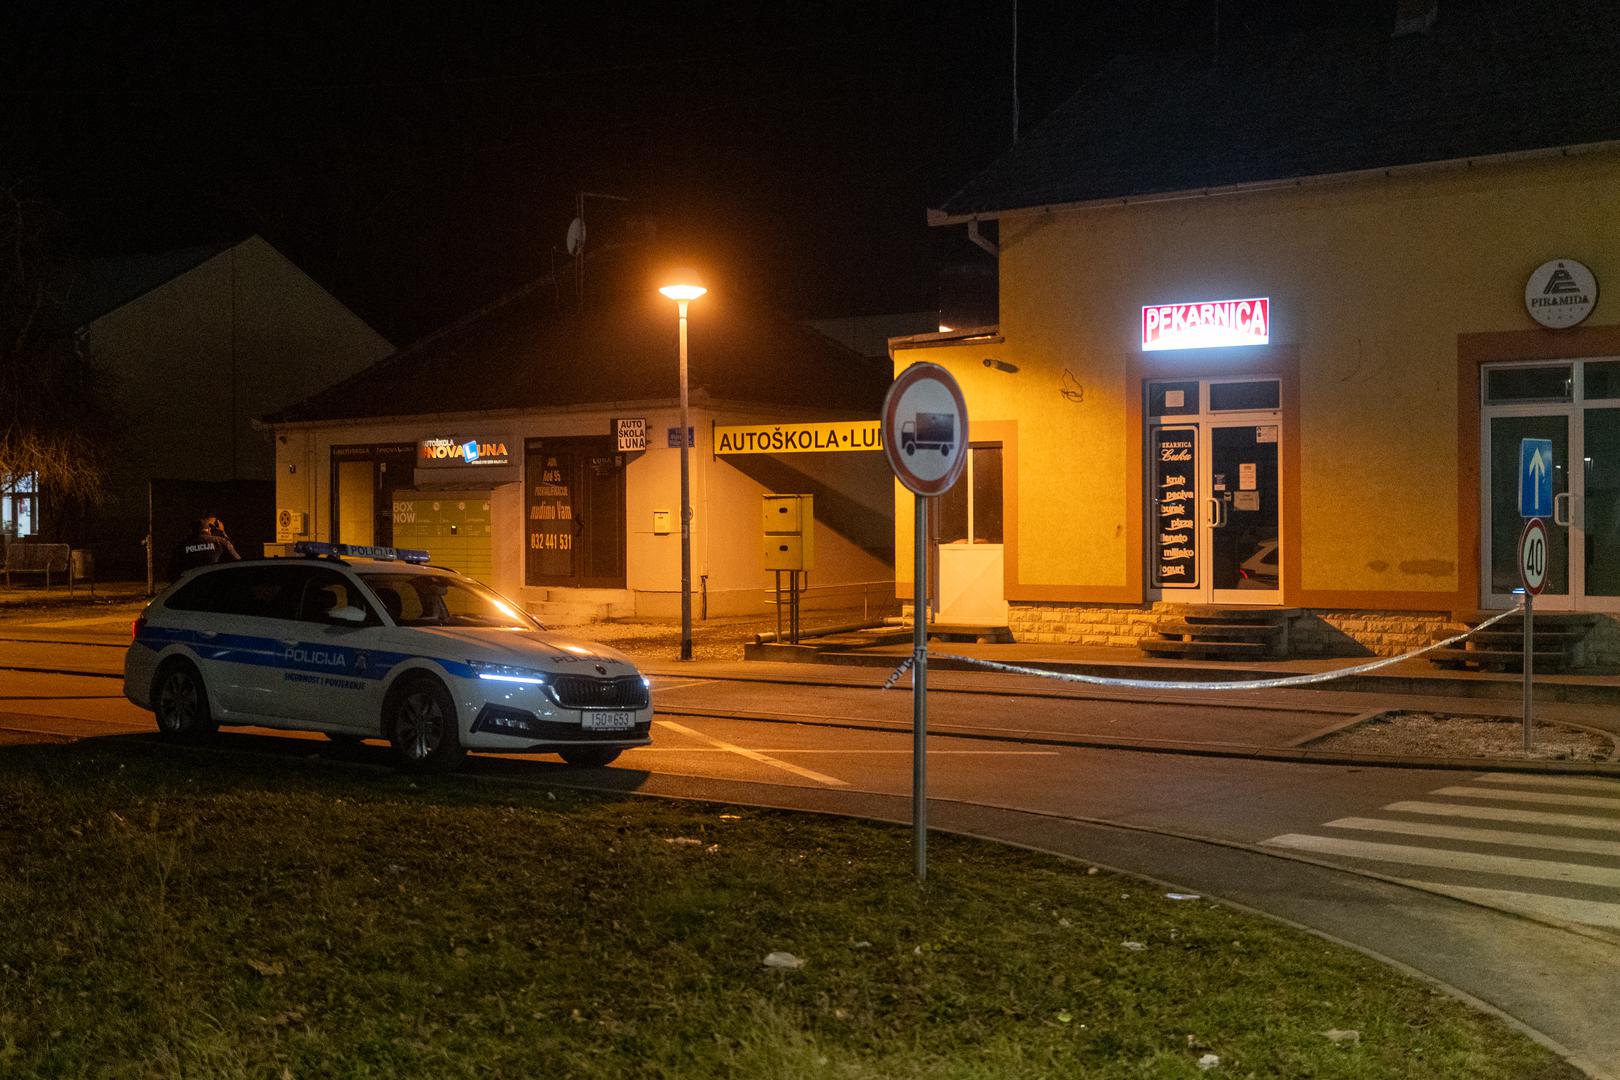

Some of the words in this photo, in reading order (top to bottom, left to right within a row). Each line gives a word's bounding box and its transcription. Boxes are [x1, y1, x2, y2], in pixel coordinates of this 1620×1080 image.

[1532, 295, 1588, 307] PIRAMIDA
[1145, 301, 1267, 342] PEKARNICA
[621, 420, 643, 429] AUTO
[618, 428, 645, 438] ŠKOLA
[719, 427, 840, 451] AUTOŠKOLA
[619, 439, 645, 449] LUNA
[393, 501, 414, 513] BOX
[393, 512, 416, 523] NOW
[531, 533, 544, 549] 032
[545, 533, 557, 549] 441
[559, 533, 572, 550] 531
[185, 542, 216, 555] POLICIJA
[351, 545, 394, 558] POLICIJA
[1526, 538, 1543, 576] 40
[285, 647, 346, 667] POLICIJA
[613, 712, 629, 726] 653
